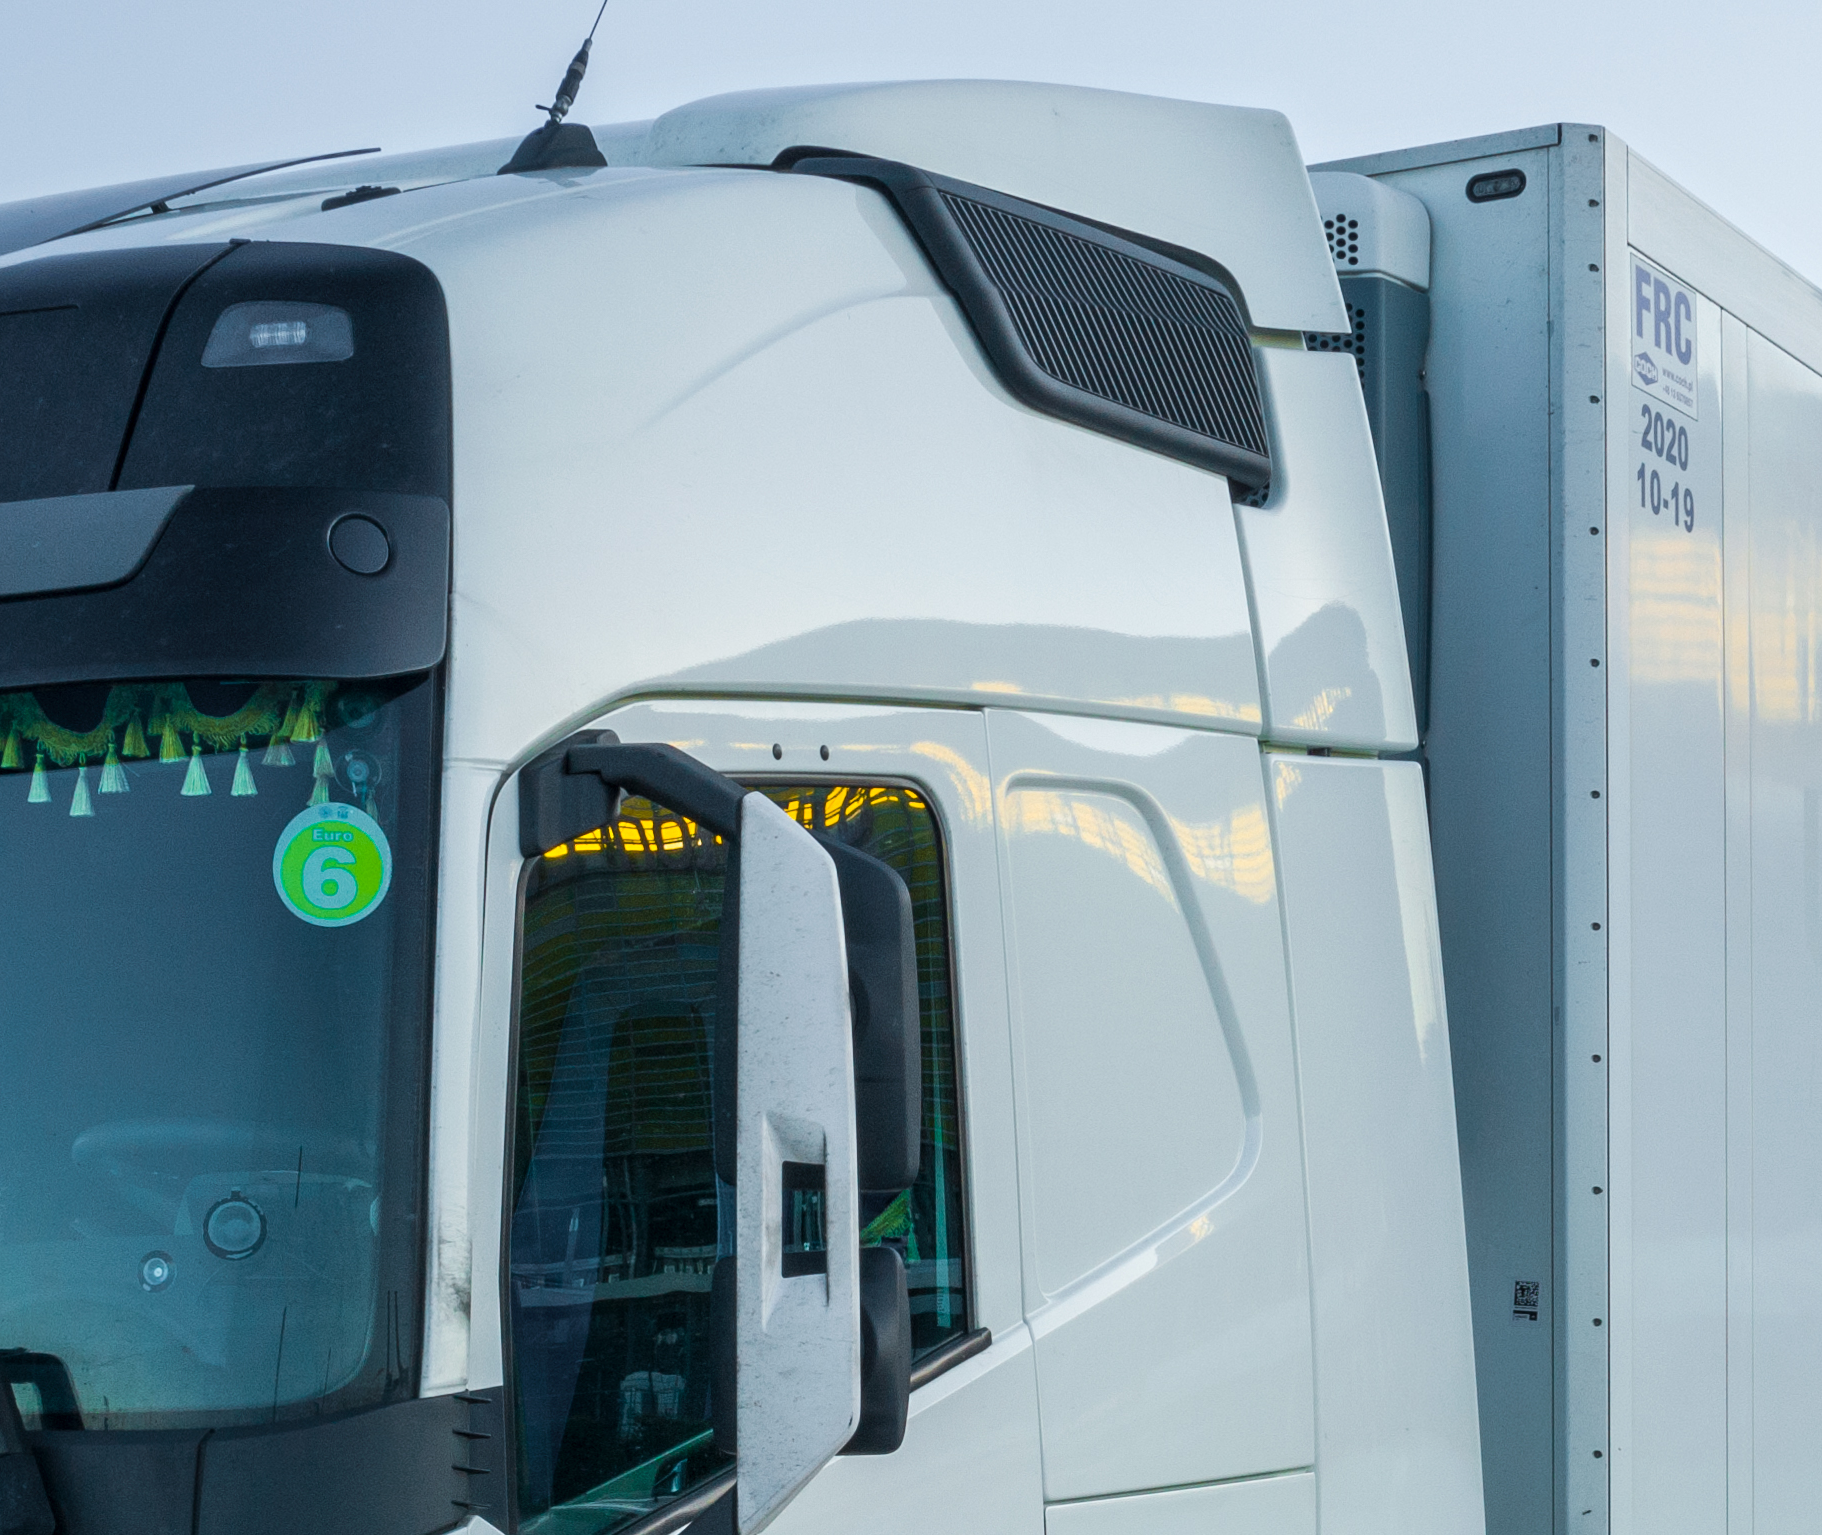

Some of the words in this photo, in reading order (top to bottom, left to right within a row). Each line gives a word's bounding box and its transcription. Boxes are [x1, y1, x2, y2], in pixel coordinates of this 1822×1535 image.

[1635, 264, 1692, 366] FRC
[1641, 403, 1689, 472] 2020
[1637, 462, 1695, 533] 10-19
[312, 828, 354, 842] Euro
[302, 844, 358, 909] 6
